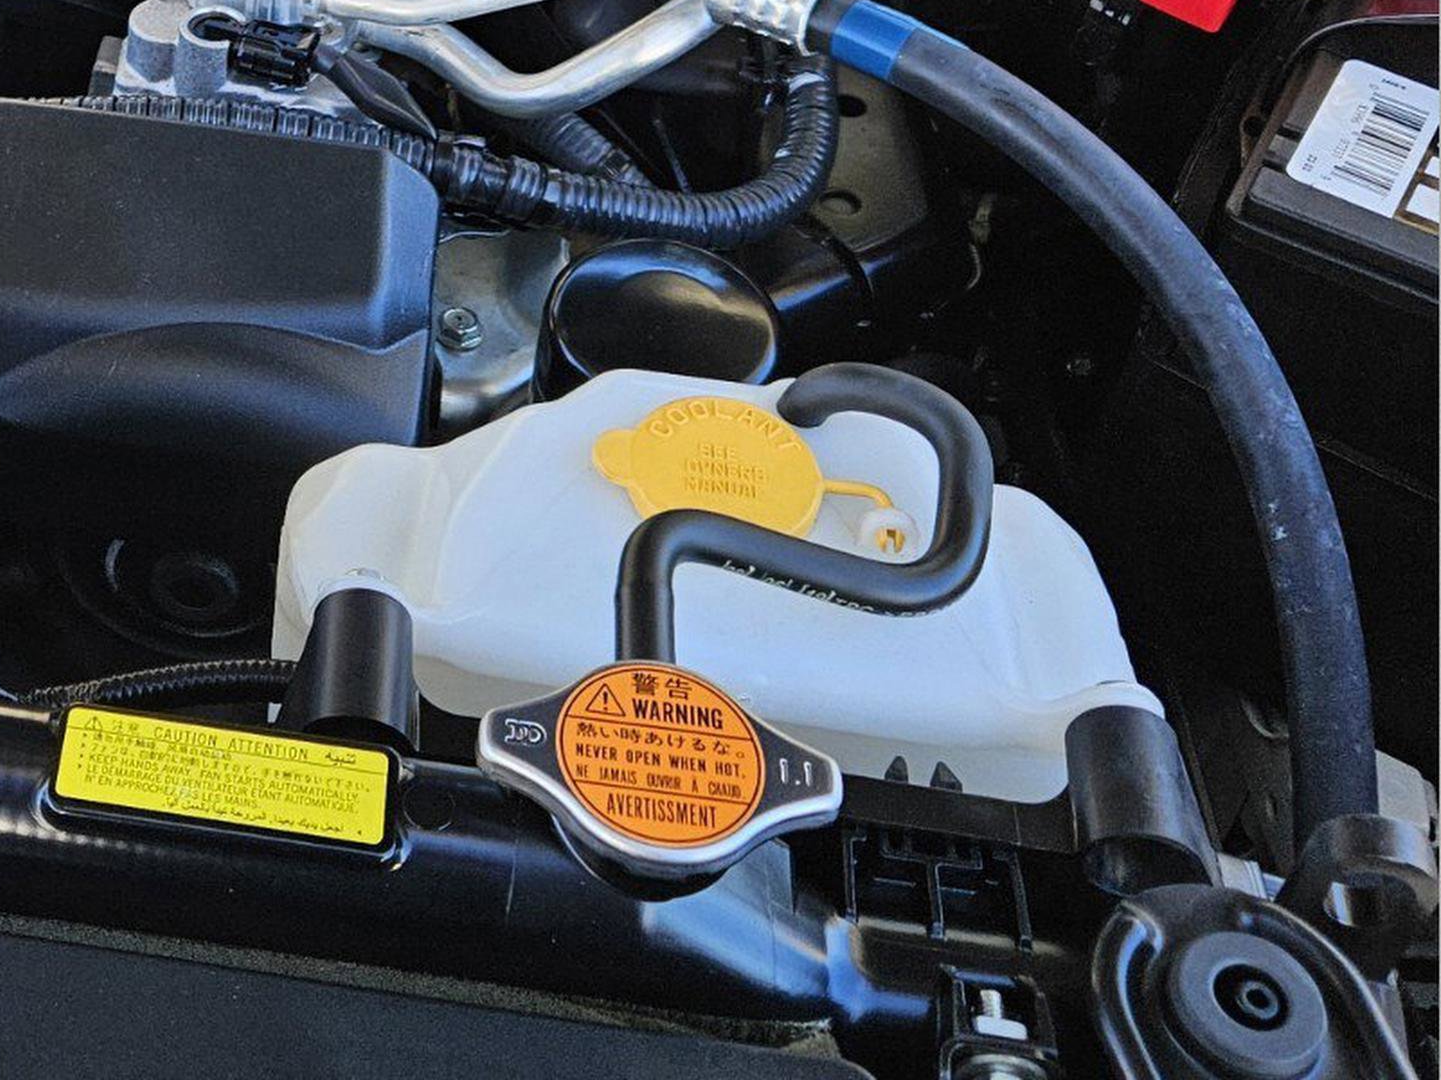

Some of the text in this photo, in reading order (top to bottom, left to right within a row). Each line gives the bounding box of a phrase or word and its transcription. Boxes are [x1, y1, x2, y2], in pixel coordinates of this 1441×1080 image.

[650, 399, 802, 454] COOLANT
[632, 672, 693, 701] 警告
[632, 697, 724, 731] WARNING
[153, 726, 217, 746] CAUTION
[228, 738, 308, 760] ATTENTION
[575, 743, 618, 762] NEVER
[625, 749, 661, 766] OPEN
[668, 754, 708, 773] WHEN
[88, 753, 119, 766] KEEP
[121, 758, 160, 772] HANDS
[199, 769, 221, 781] FAN
[225, 773, 265, 788] STARTS
[575, 764, 589, 779] NE
[599, 766, 638, 786] JAMAIS
[645, 771, 682, 790] OUVRIR
[778, 756, 813, 788] 1.1
[606, 792, 718, 829] AVERTISSMENT
